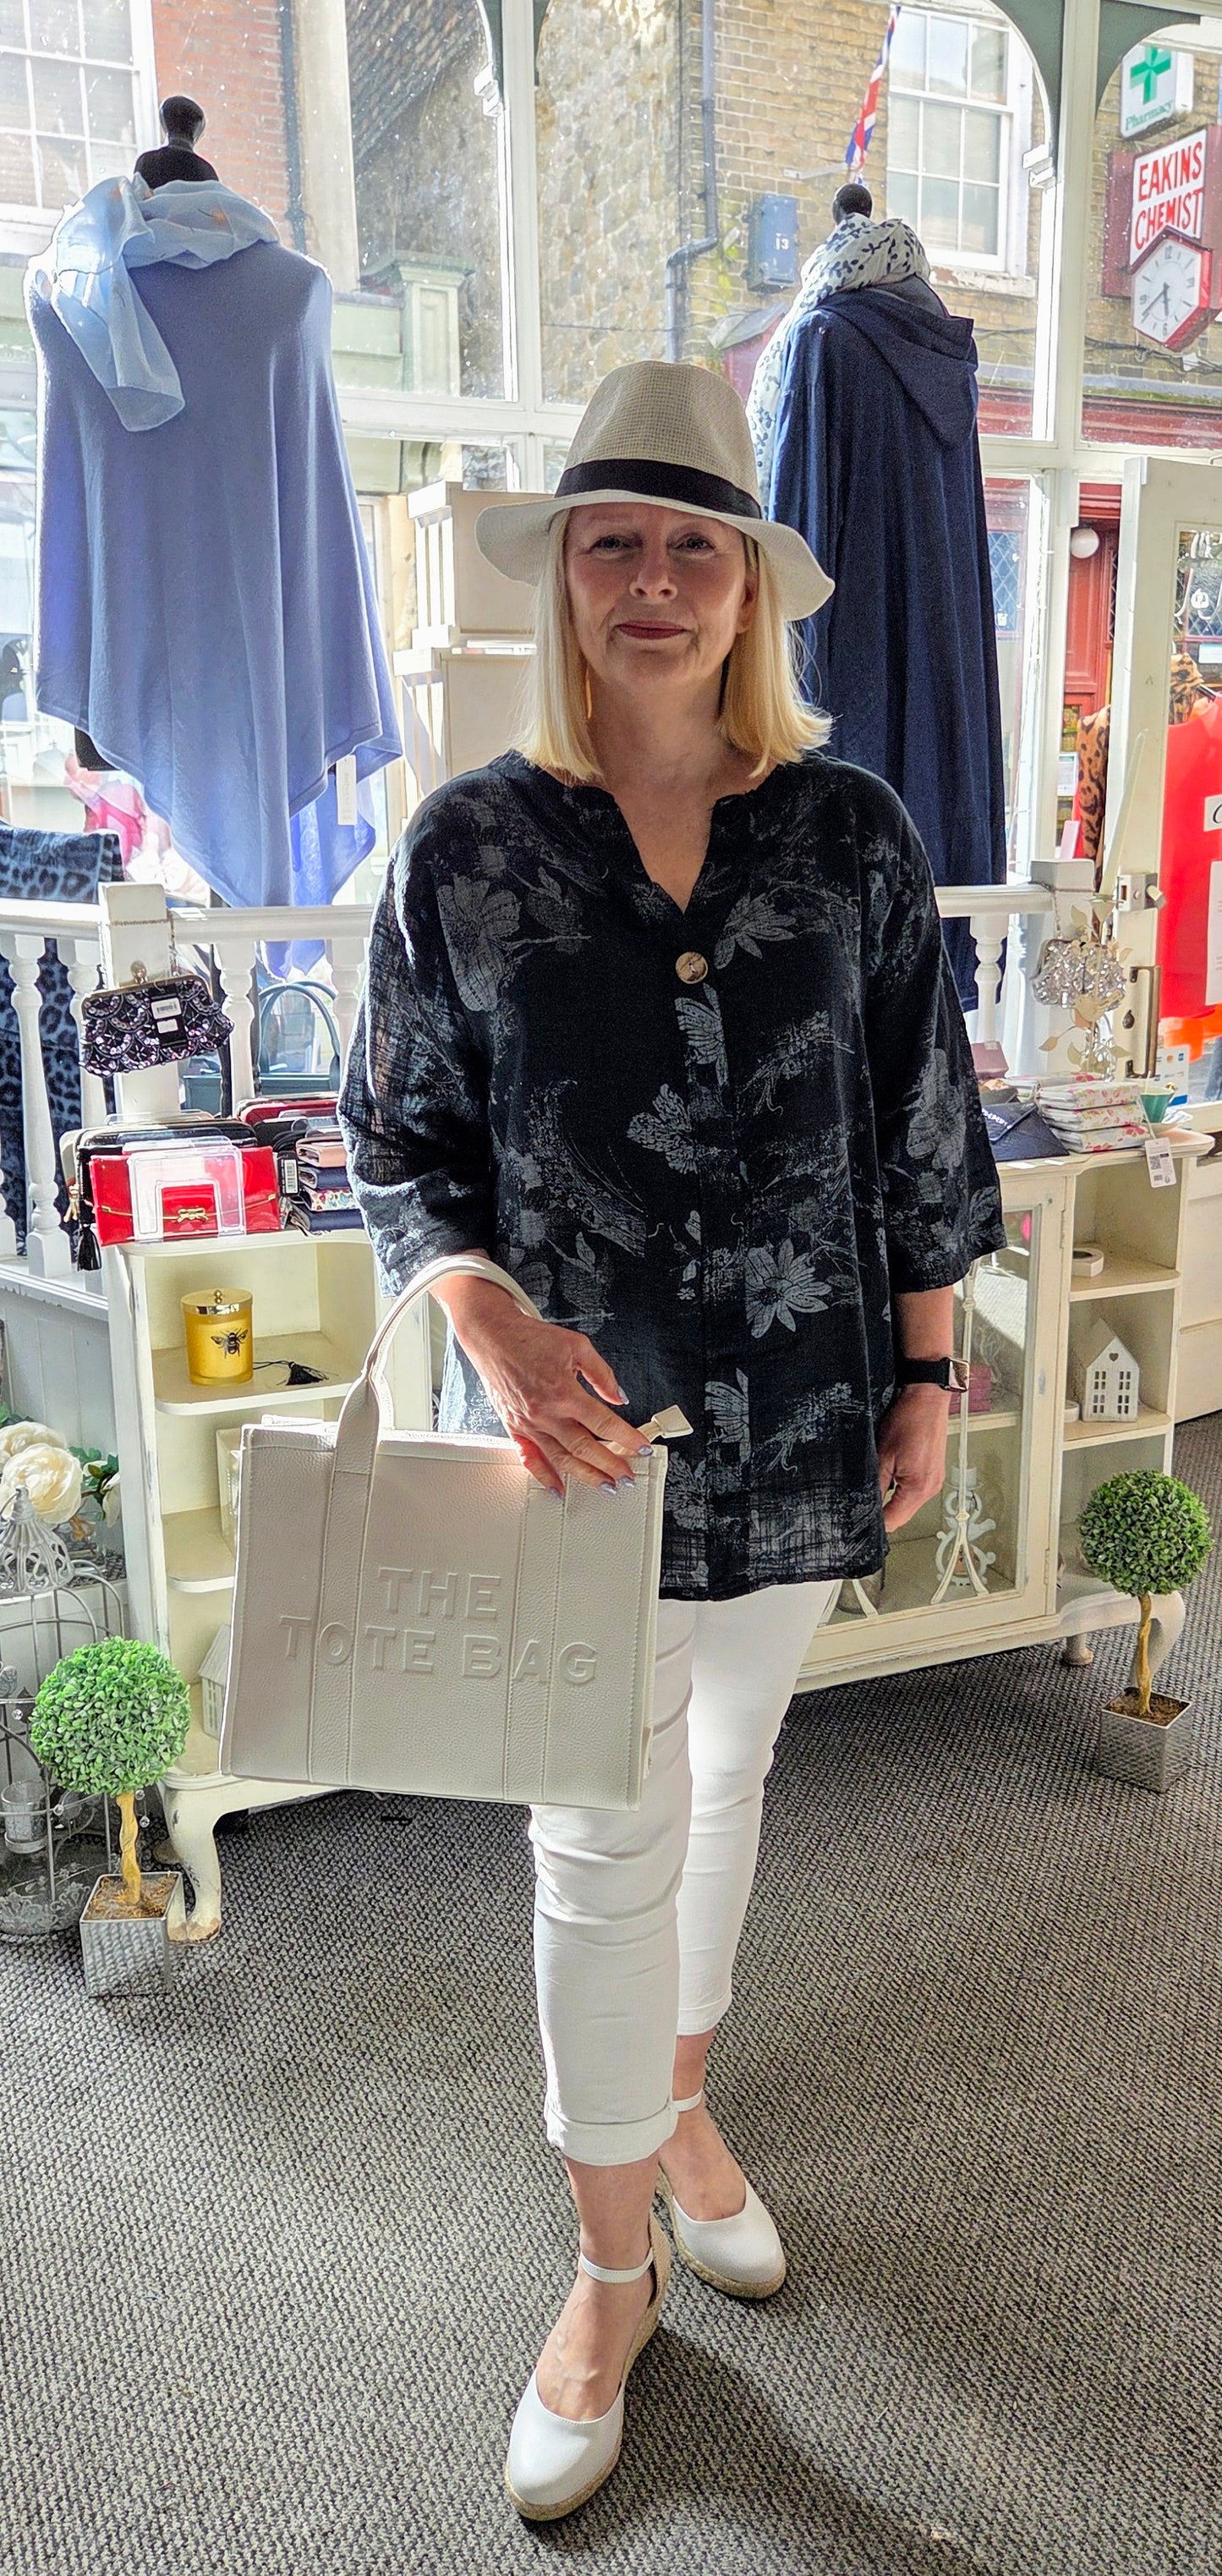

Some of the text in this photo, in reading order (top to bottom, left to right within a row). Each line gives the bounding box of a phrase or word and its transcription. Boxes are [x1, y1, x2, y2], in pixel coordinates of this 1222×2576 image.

[1125, 100, 1174, 130] Pharmacy
[1137, 141, 1203, 203] EAKINS
[1134, 188, 1204, 250] CHEMIST
[378, 1566, 502, 1620] THE
[279, 1615, 599, 1685] TOTE BAG
